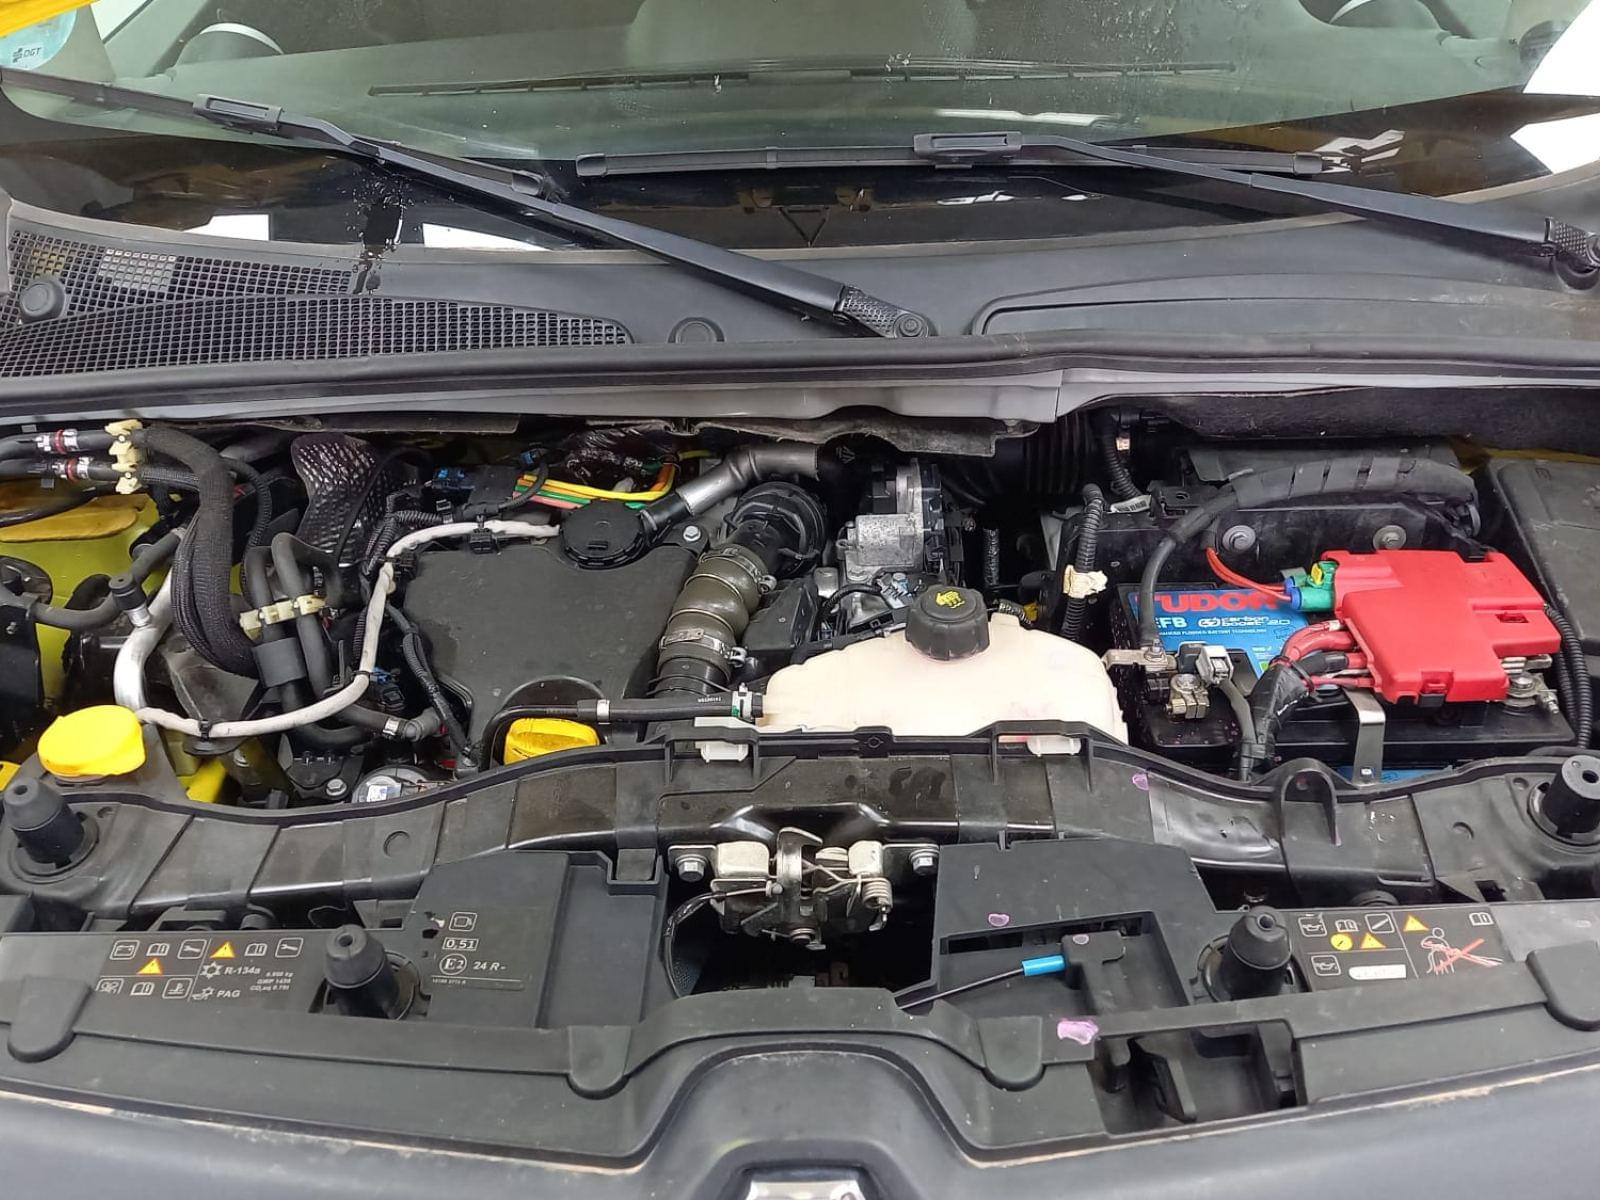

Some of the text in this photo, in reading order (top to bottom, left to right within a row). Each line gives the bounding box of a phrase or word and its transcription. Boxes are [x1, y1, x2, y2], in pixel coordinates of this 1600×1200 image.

[23, 47, 41, 57] DGT
[446, 939, 475, 950] 0,51
[444, 958, 464, 970] E2
[473, 961, 488, 970] 24
[224, 966, 261, 975] R-134a
[216, 990, 241, 998] PAG
